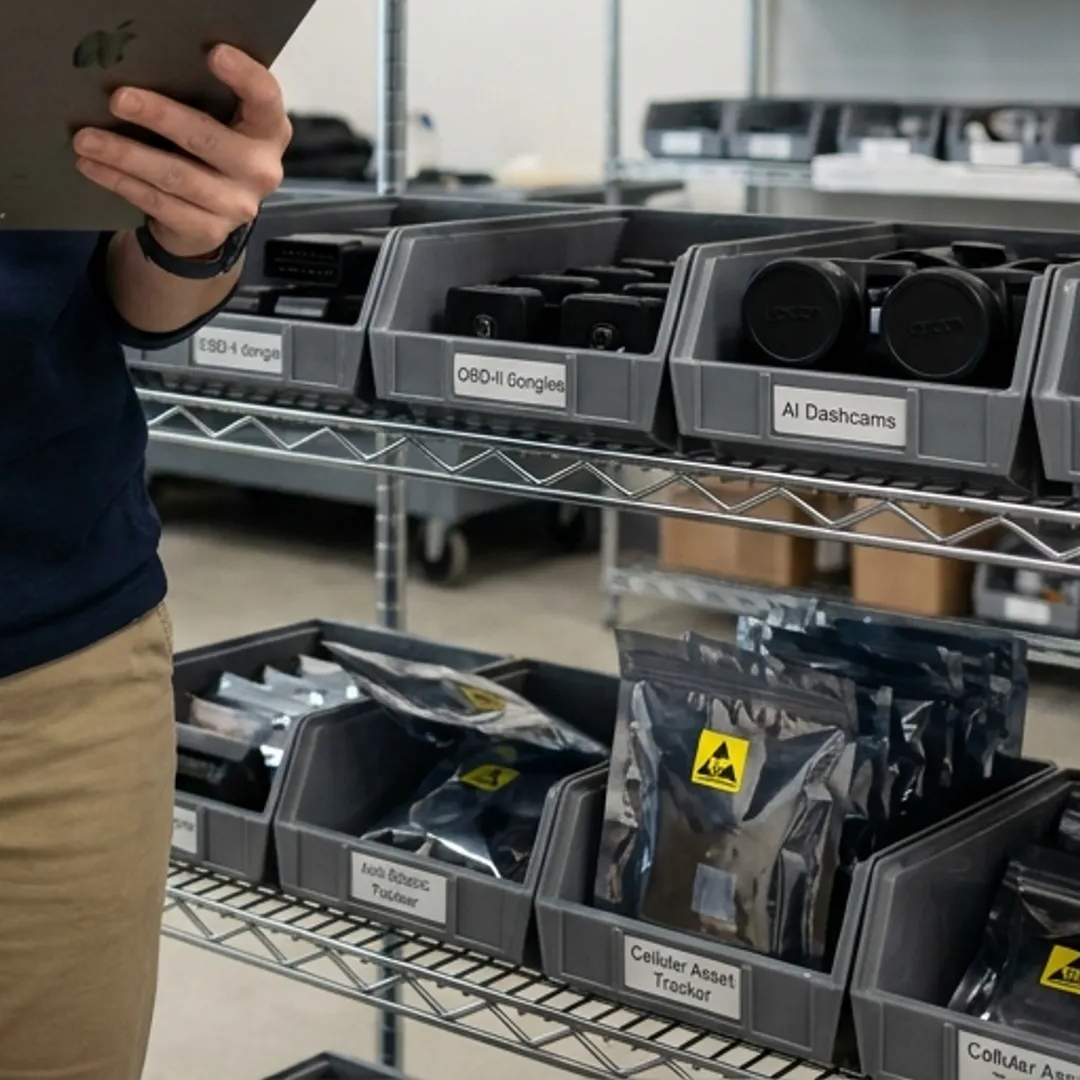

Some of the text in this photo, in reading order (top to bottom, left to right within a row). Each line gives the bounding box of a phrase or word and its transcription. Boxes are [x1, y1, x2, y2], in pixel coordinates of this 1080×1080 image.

[781, 401, 897, 430] AI Dashcams
[690, 962, 736, 990] Asset
